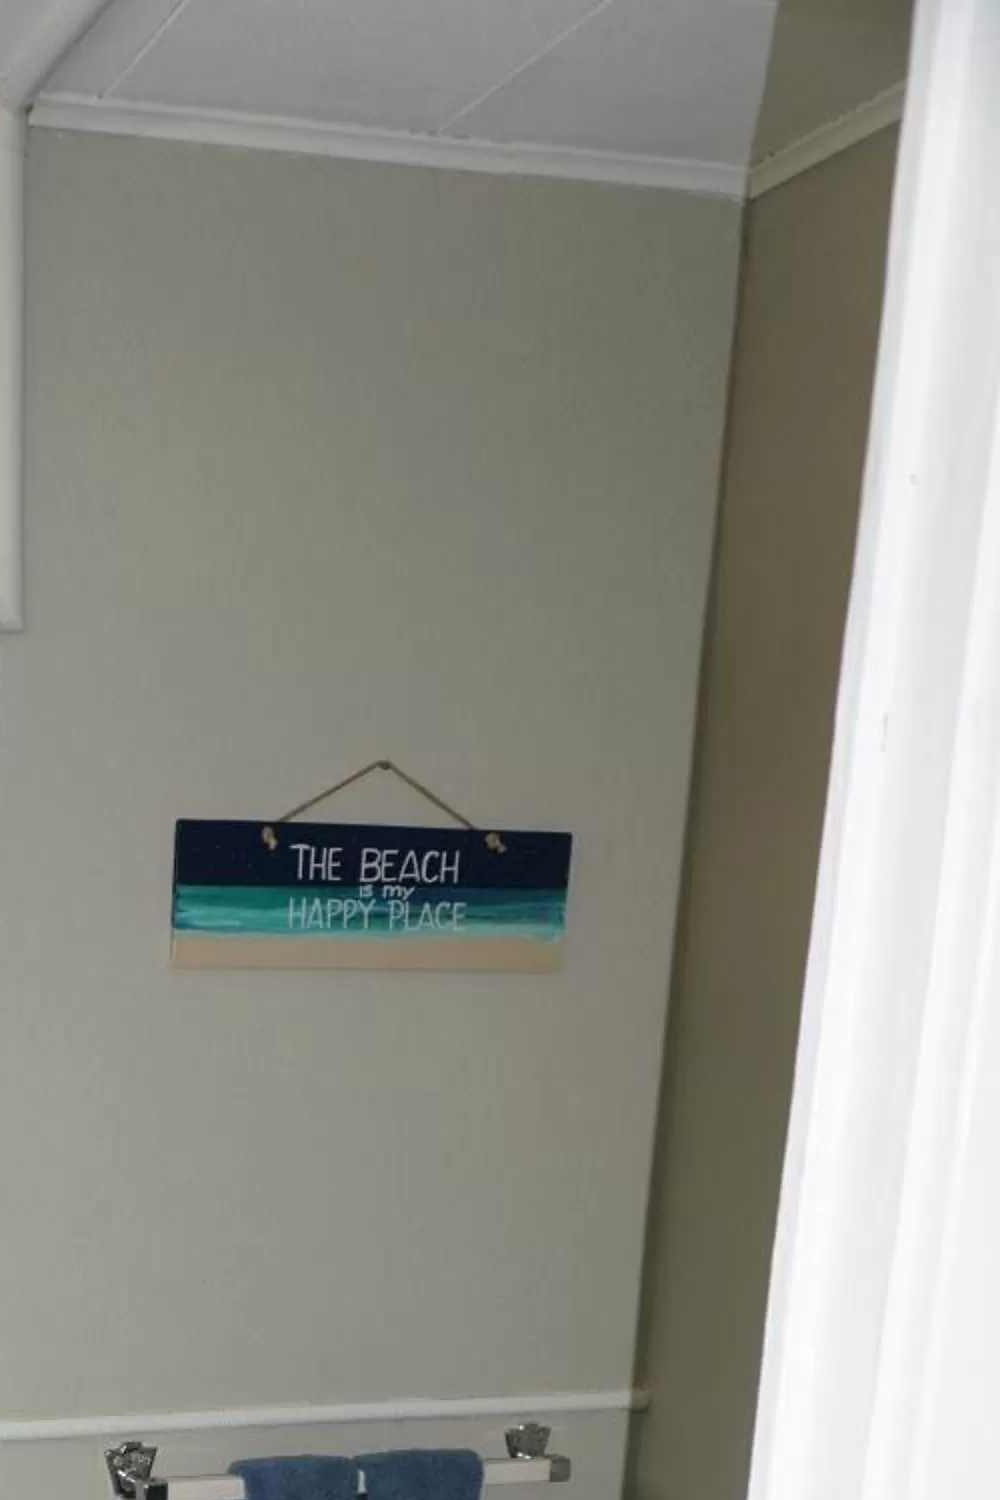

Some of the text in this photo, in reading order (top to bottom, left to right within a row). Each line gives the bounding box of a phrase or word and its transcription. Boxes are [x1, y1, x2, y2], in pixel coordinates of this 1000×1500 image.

[289, 843, 461, 885] THE BEACH
[382, 884, 416, 900] my
[288, 897, 468, 932] HAPPY PLACE
